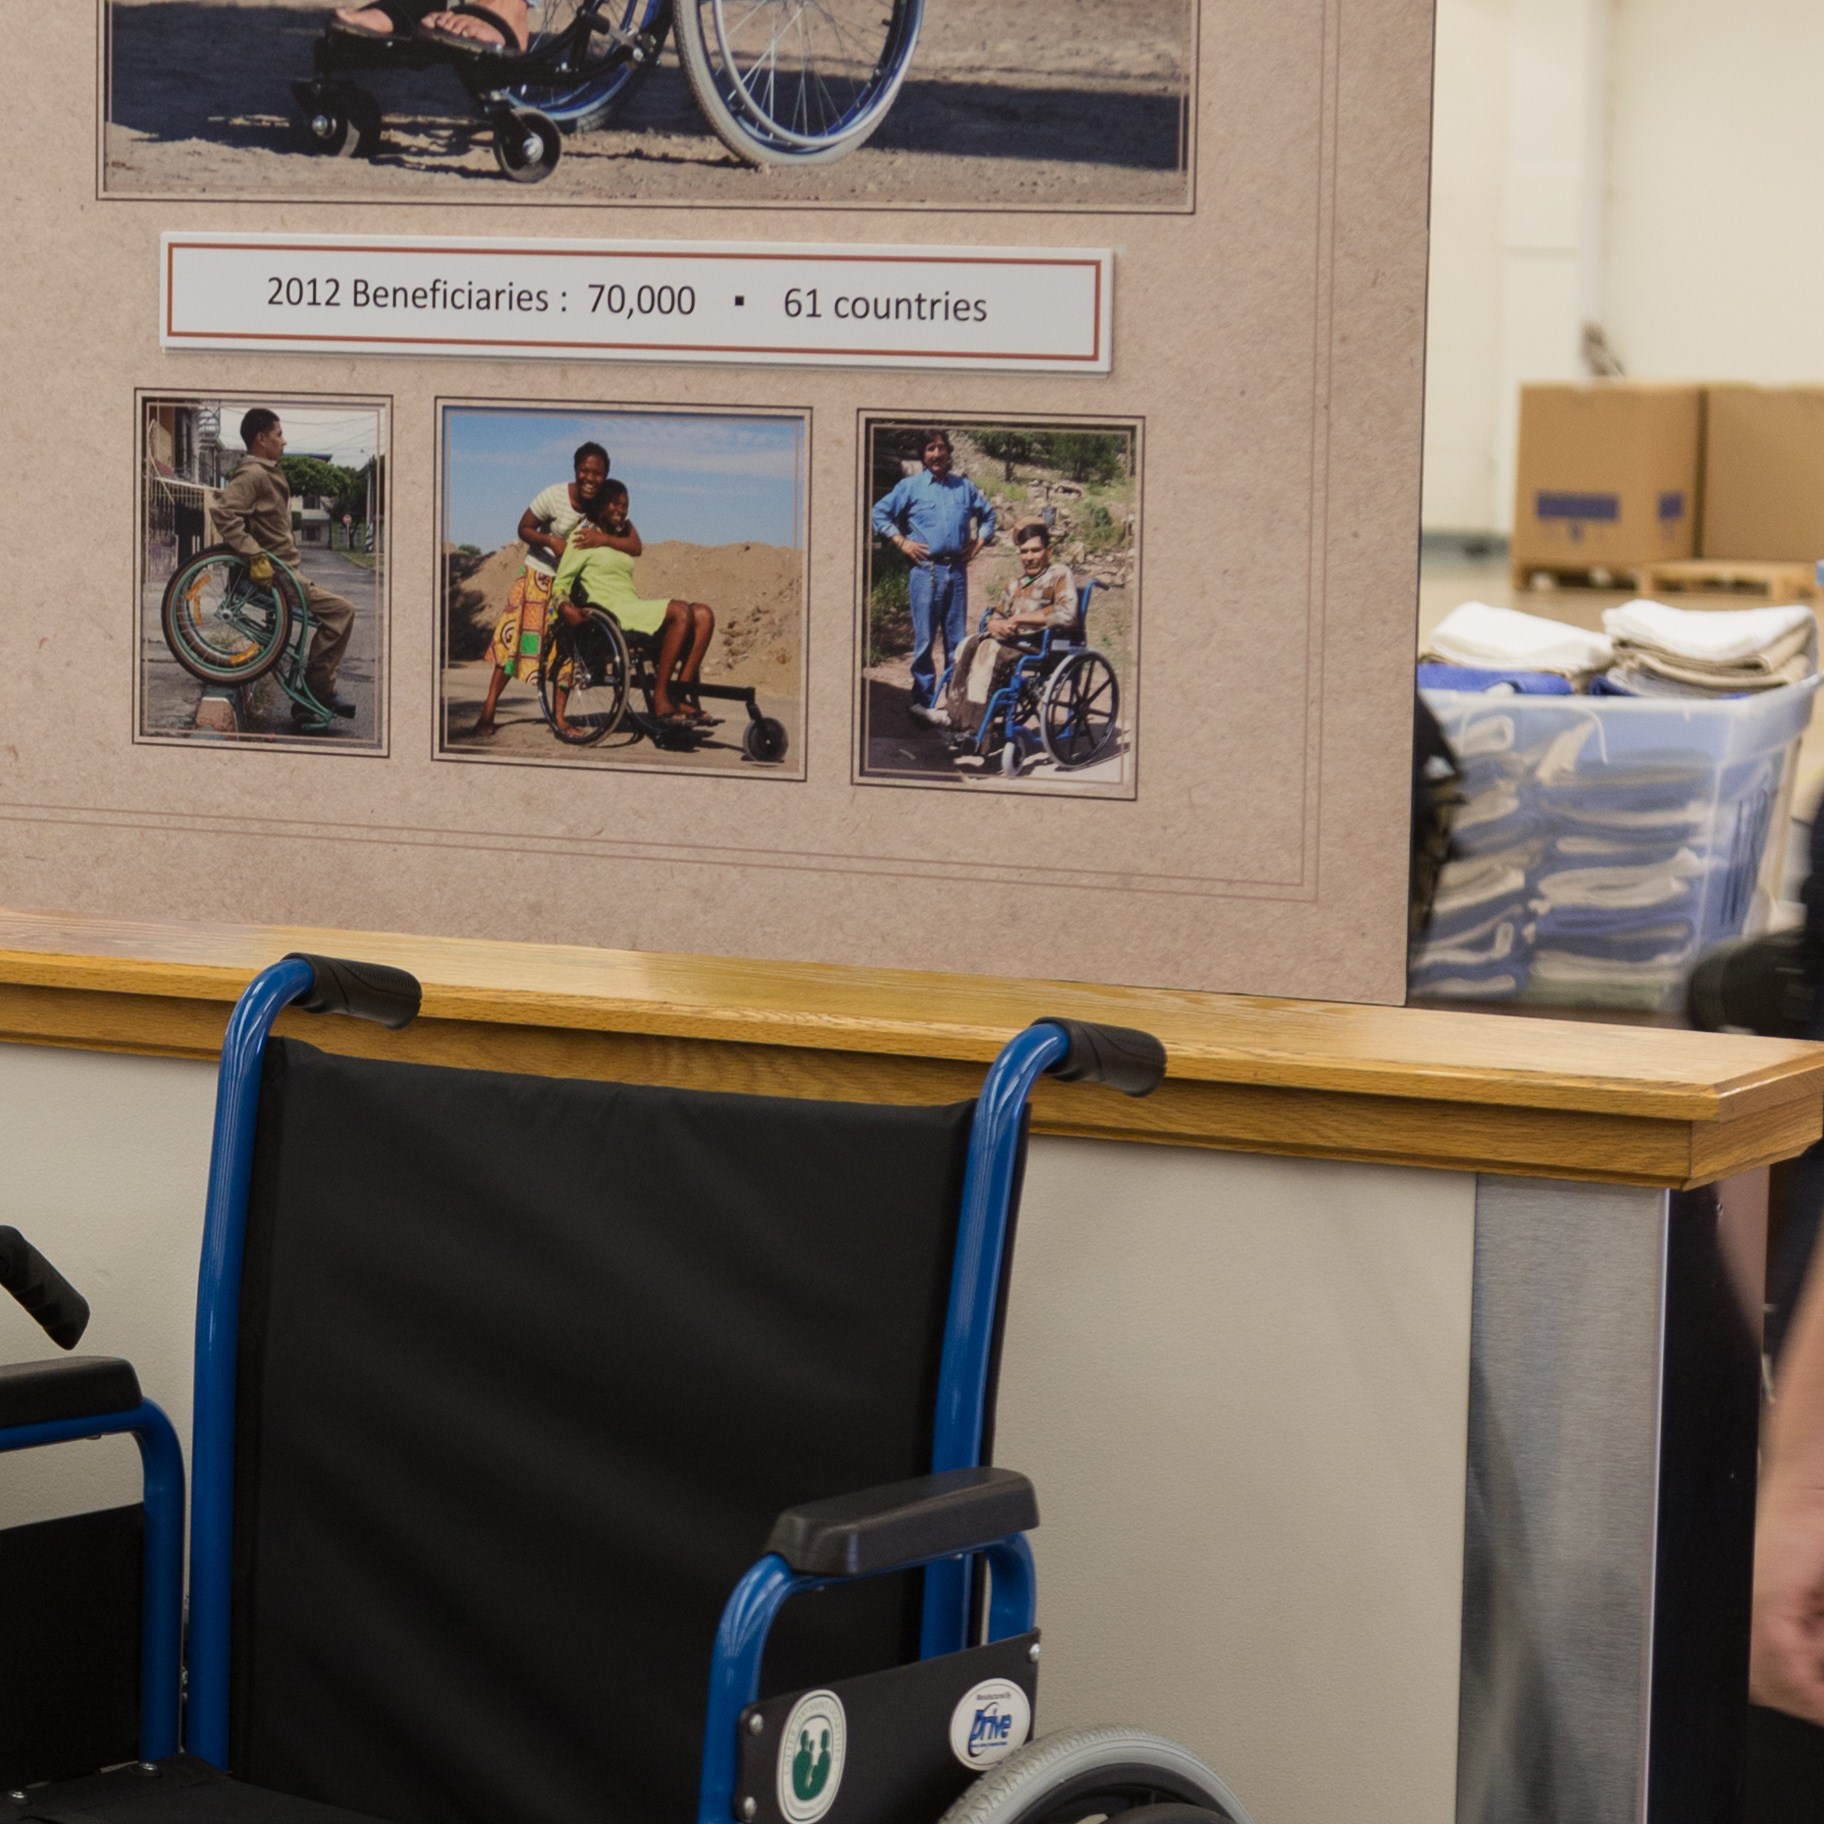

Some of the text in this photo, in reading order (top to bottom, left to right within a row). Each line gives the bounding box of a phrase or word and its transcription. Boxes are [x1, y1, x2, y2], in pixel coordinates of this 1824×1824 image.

[267, 276, 342, 308] 2012
[351, 278, 549, 313] Beneficiaries
[587, 284, 697, 319] 70,000
[783, 287, 823, 318] 61
[833, 290, 988, 324] countries
[970, 1708, 1013, 1741] Drive
